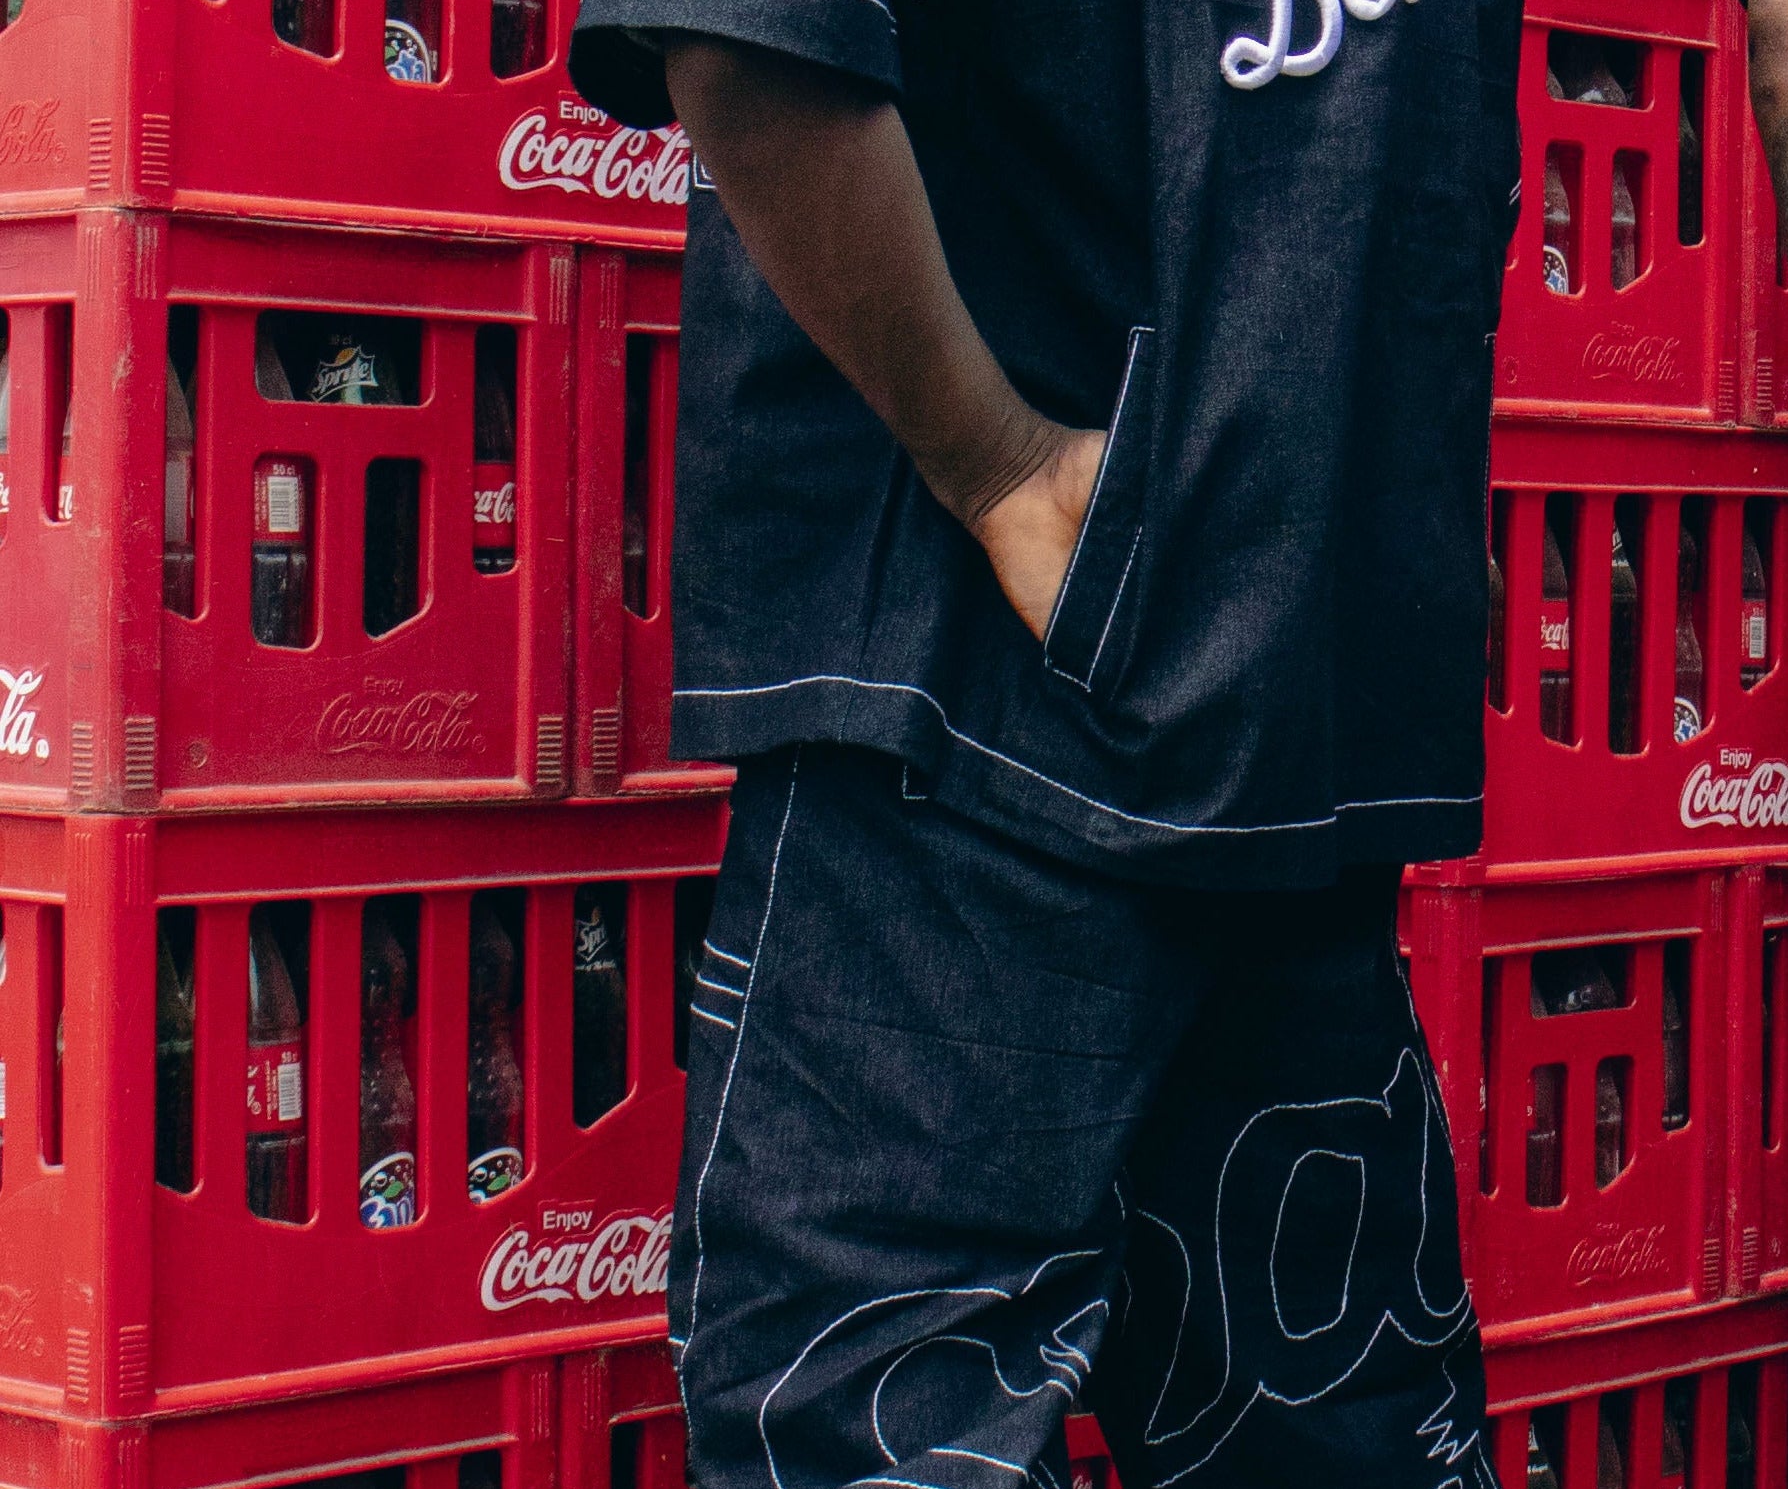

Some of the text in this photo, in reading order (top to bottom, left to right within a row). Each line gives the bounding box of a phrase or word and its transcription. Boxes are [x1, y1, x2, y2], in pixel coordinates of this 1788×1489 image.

[560, 101, 607, 125] Enjoy
[1720, 750, 1752, 769] Enjoy
[543, 1211, 592, 1230] Enjoy
